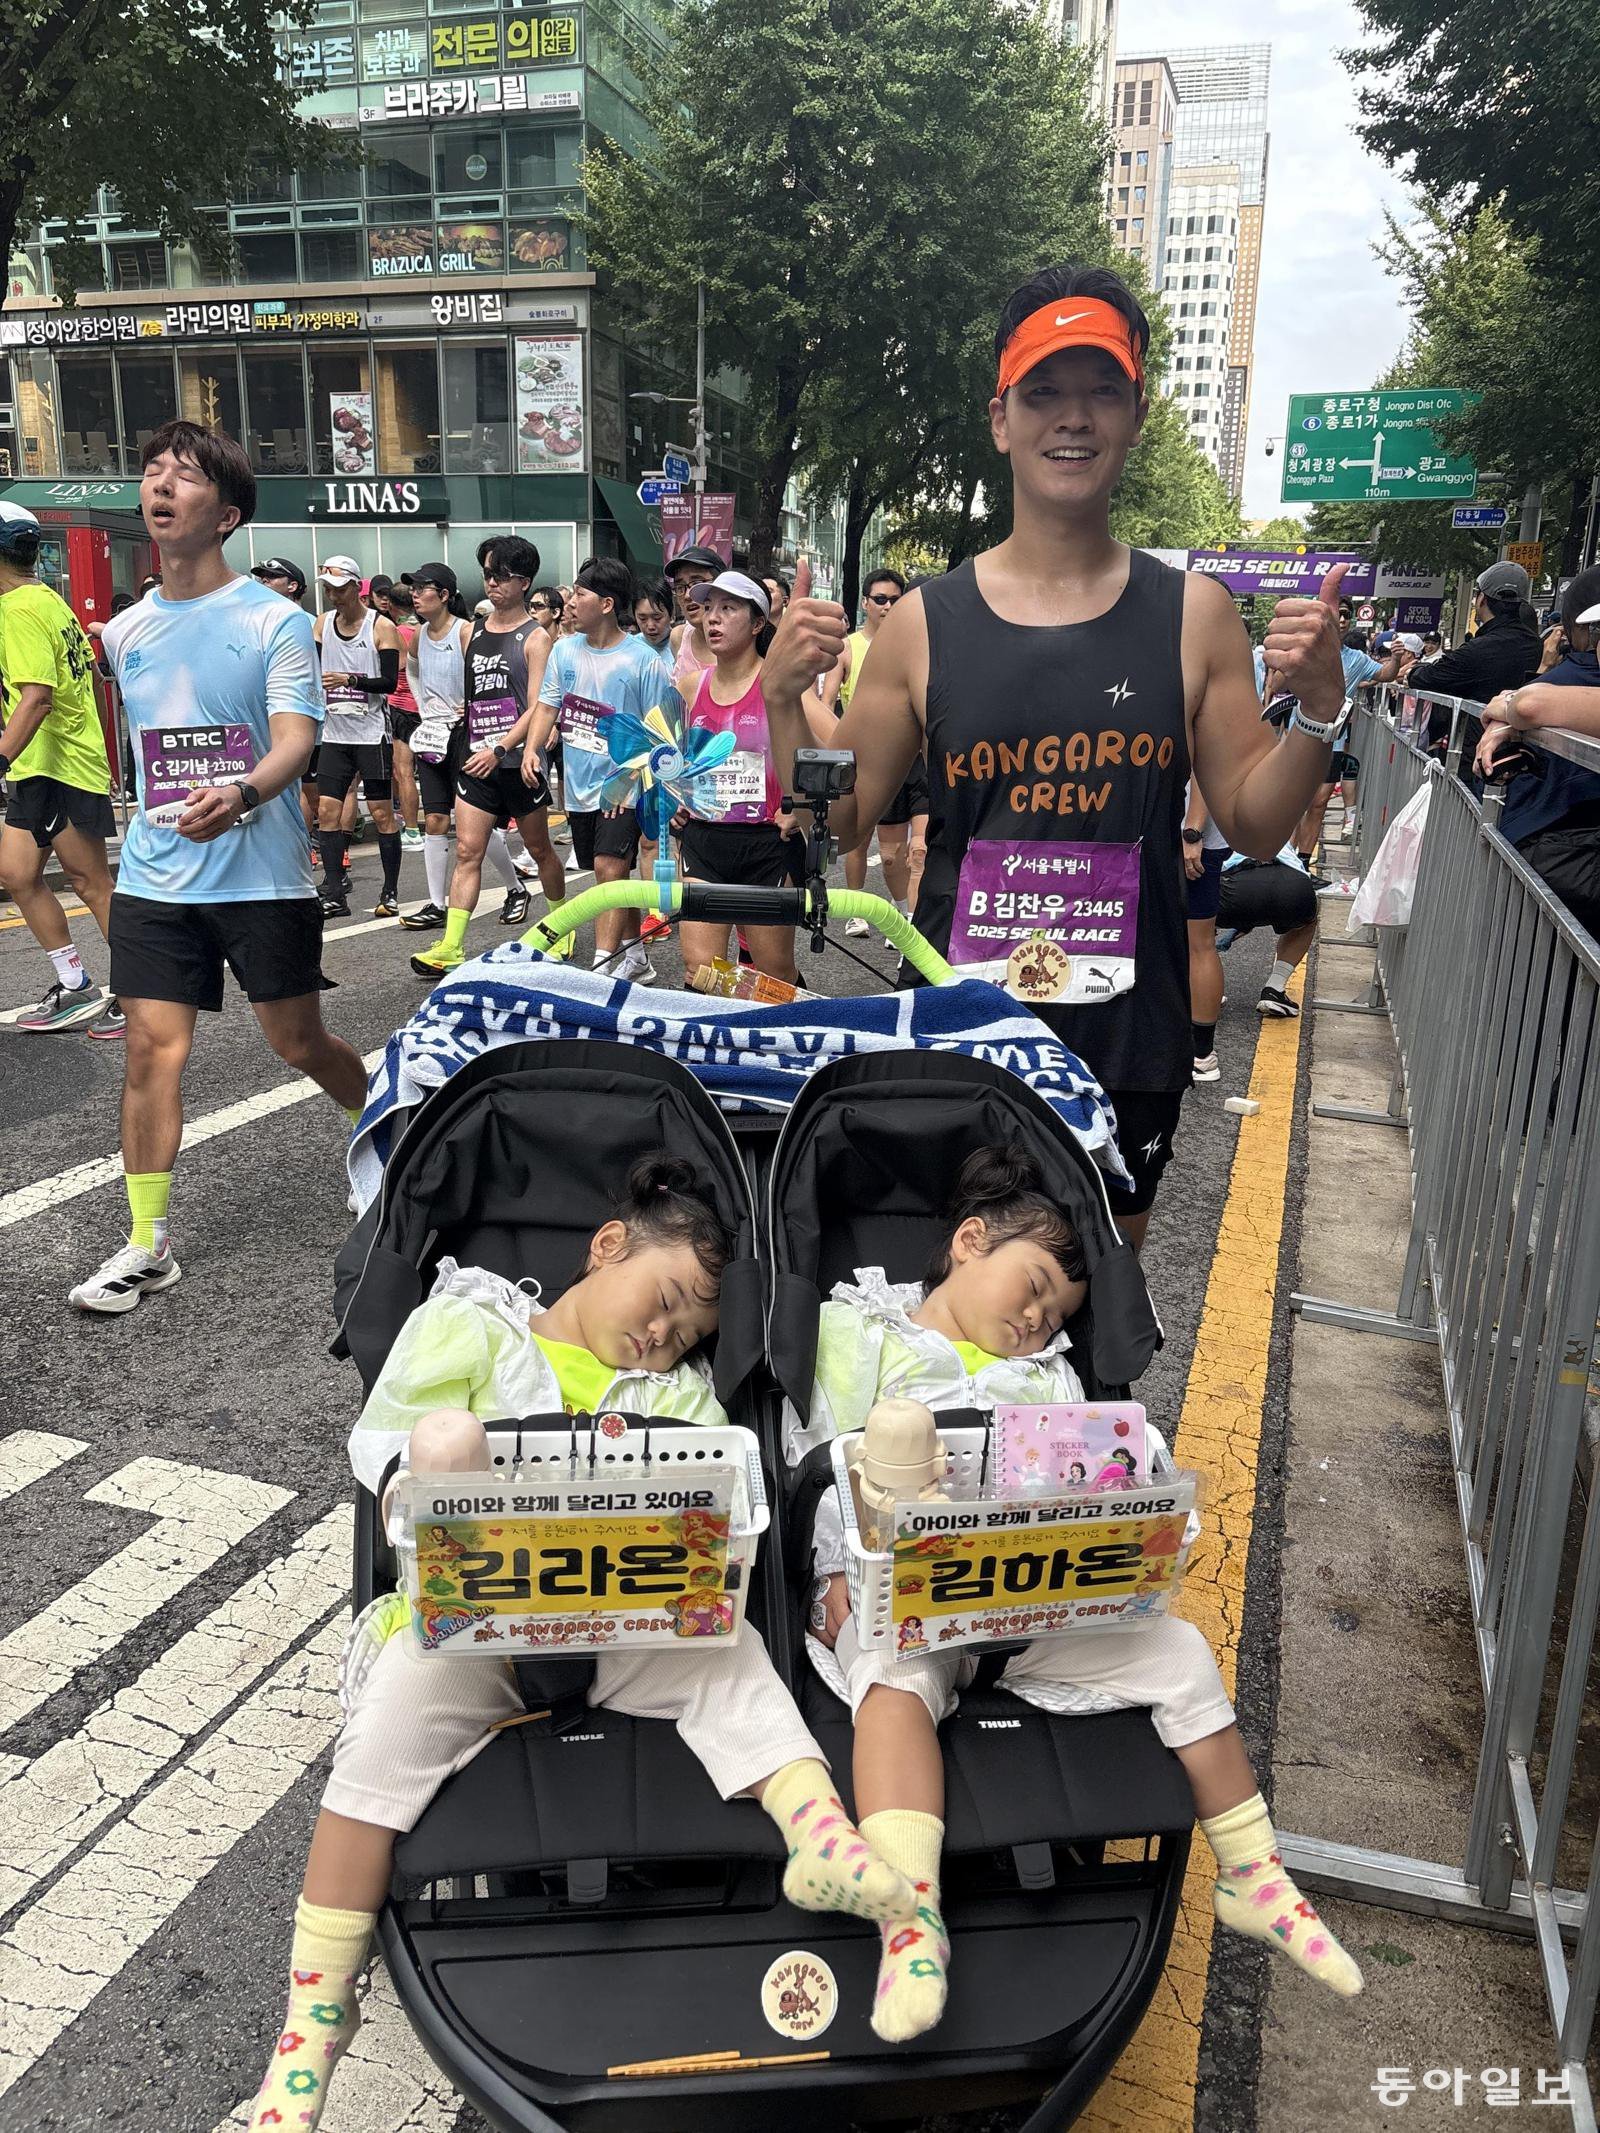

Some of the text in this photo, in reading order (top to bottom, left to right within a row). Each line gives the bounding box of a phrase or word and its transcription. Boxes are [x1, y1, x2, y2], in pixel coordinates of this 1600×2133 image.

[544, 19, 571, 36] 야간
[376, 27, 411, 51] 치과
[432, 19, 538, 67] 전문의
[544, 37, 571, 54] 진료
[367, 52, 421, 75] 보존과
[363, 74, 527, 120] 3F 브라주카 그릴
[373, 253, 475, 275] BRAZUCA GRILL
[166, 302, 250, 333] 라민의원
[431, 294, 503, 325] 왕비집
[254, 311, 360, 331] 피부과 가정의학과
[1323, 397, 1452, 413] 종로구청 Jongno Dist Ofc
[1308, 419, 1316, 428] 6
[1325, 414, 1378, 430] 종로1가
[1383, 419, 1412, 430] Jongno
[1294, 445, 1303, 455] 31
[1288, 458, 1336, 473] 청계광장
[1419, 457, 1447, 471] 광교
[1286, 474, 1334, 486] Cheonggye Plaza
[1417, 473, 1473, 485] Gwanggyo
[45, 482, 125, 496] LINA'S
[325, 482, 421, 513] LINA'S
[1365, 488, 1390, 497] 110m
[1456, 510, 1480, 519] 다동길
[1191, 558, 1244, 573] 2025
[1243, 559, 1310, 575] SEOUL
[474, 673, 507, 695] 달림이
[565, 708, 572, 718] B
[162, 732, 223, 748] BTRC
[151, 758, 246, 777] C 김기남 23700
[945, 730, 1174, 788] KANGAROO
[153, 781, 177, 791] 2025
[177, 778, 213, 789] SEOUL
[1010, 781, 1112, 815] CREW
[1023, 858, 1091, 875] 서울특별시
[968, 890, 1124, 920] B 김찬우 23445
[966, 924, 1008, 940] 2025
[1070, 928, 1122, 942] RACE
[1027, 988, 1050, 999] CREW
[1085, 985, 1111, 994] PUMA
[1050, 1441, 1089, 1449] STICKER
[432, 1490, 714, 1516] 아이와 함께 달리고 있어요
[912, 1498, 1176, 1531] 아이와 함께 달리고 있어요
[510, 1523, 639, 1539] 저를 응원해 주세요
[982, 1528, 1100, 1548] 저를 응원해 주세요
[458, 1543, 690, 1602] 김라온
[929, 1542, 1145, 1603] 김하온
[971, 1608, 1068, 1633] KANGAROO
[1075, 1601, 1129, 1618] CREW
[420, 1604, 495, 1650] Sparkle On
[510, 1617, 678, 1637] KANGAROO CREW
[978, 1720, 1022, 1729] THULE
[560, 1733, 605, 1743] THULE
